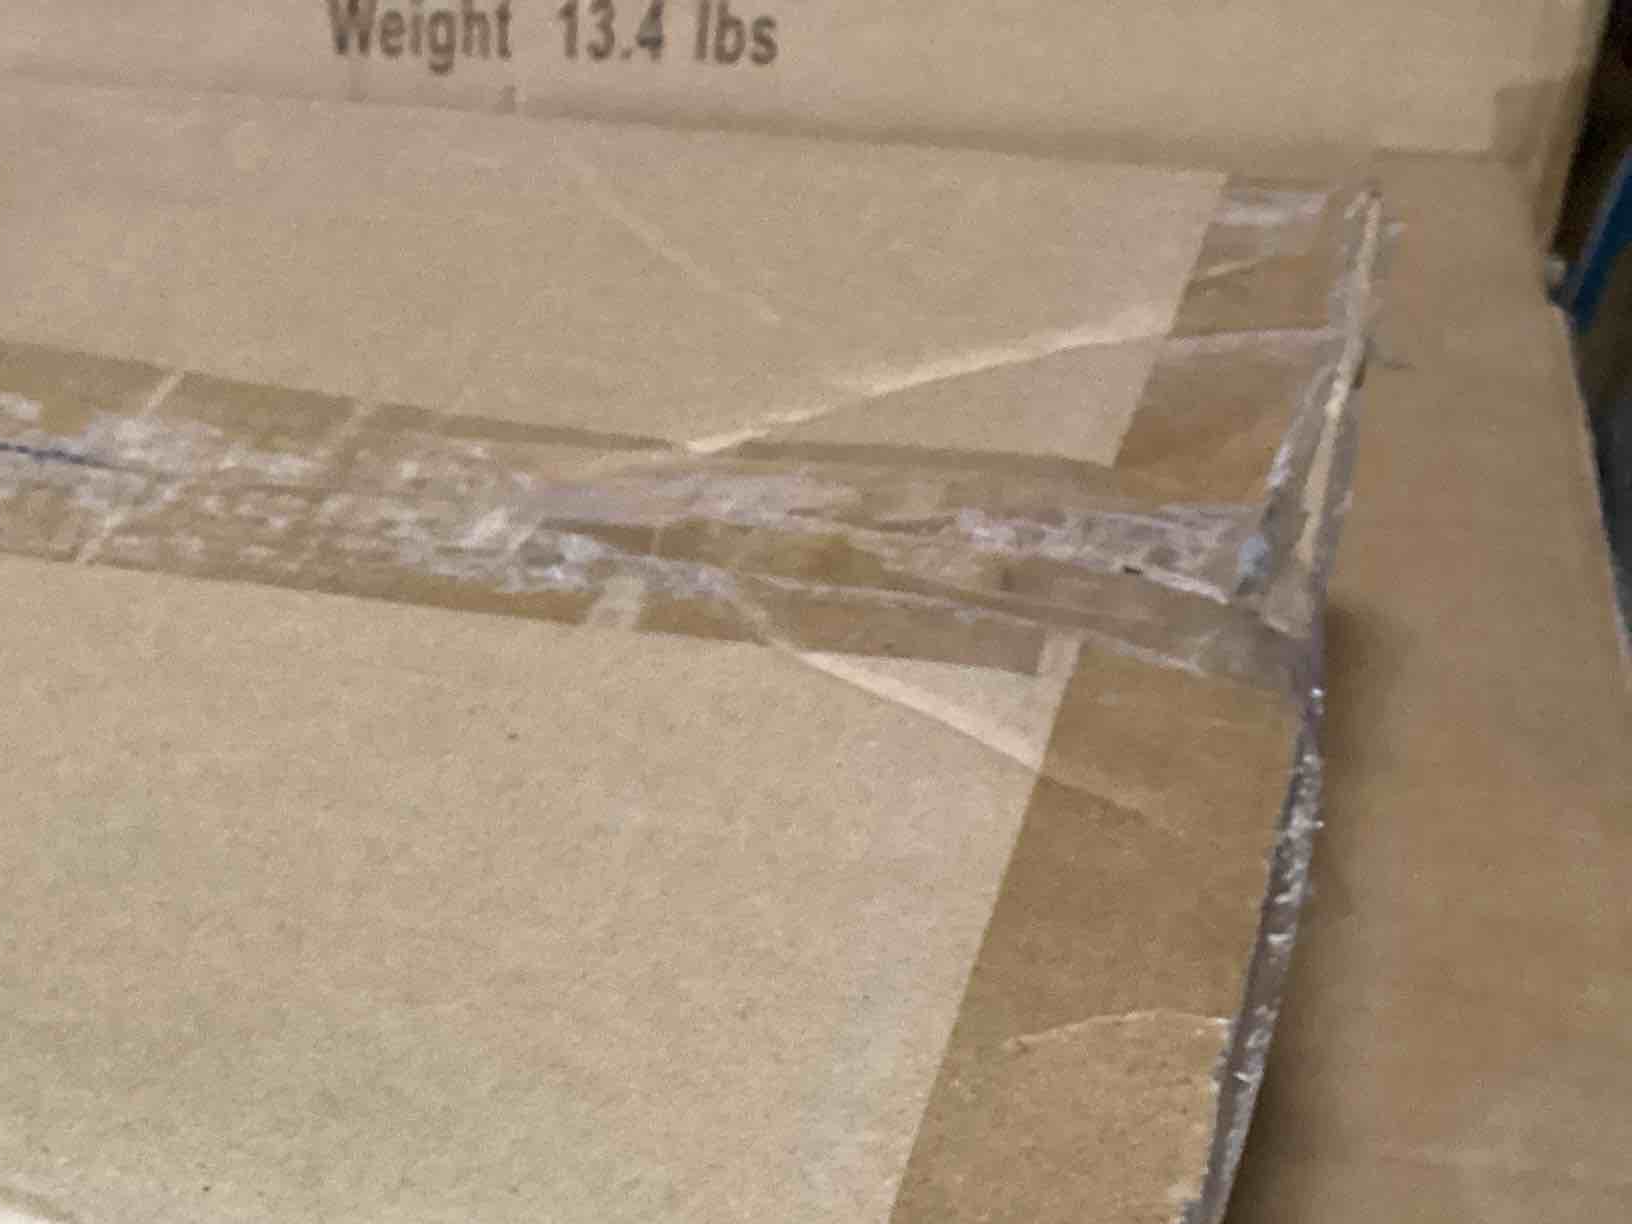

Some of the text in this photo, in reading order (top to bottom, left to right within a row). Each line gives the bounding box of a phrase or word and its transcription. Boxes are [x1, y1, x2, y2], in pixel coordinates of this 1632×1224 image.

[327, 0, 779, 76] Weight 13.4 lbs
